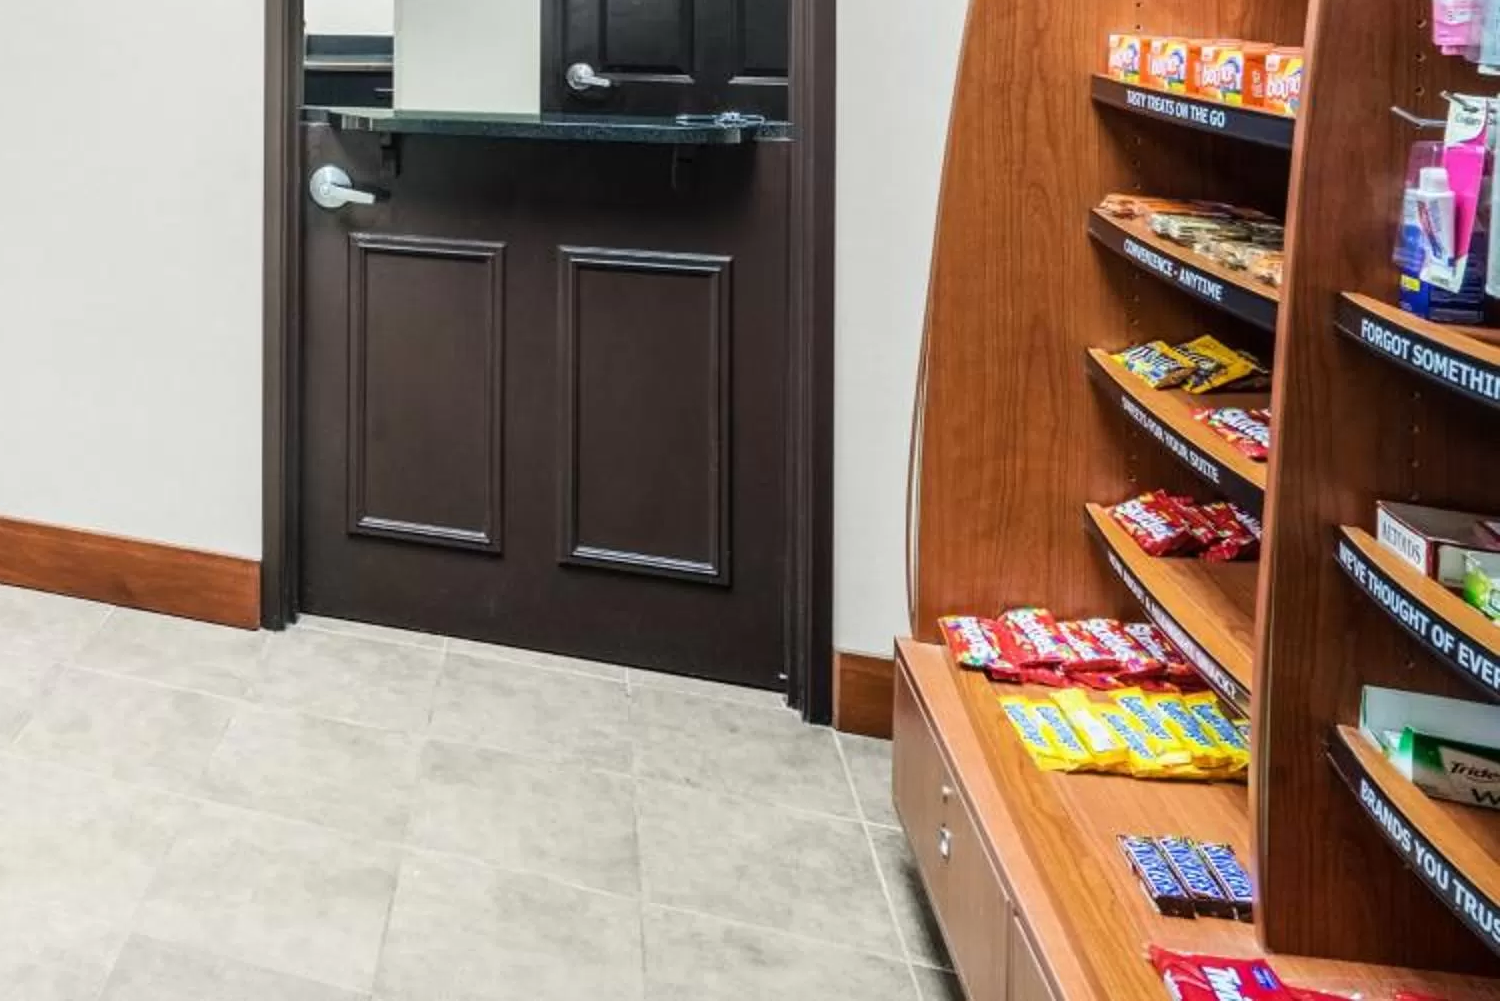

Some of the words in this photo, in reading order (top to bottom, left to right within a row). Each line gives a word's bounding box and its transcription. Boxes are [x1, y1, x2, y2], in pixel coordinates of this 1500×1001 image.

[1147, 92, 1176, 117] TREATS
[1176, 101, 1189, 119] ON
[1190, 104, 1209, 126] THE
[1209, 110, 1227, 129] GO
[1122, 237, 1174, 278] CONVENIENCE
[1179, 267, 1225, 302] ANYTIME
[1360, 318, 1409, 360] FORGOT
[1366, 567, 1431, 637] THOUGHT
[1430, 623, 1456, 654] OF
[1359, 777, 1412, 853] BRANDS
[1413, 838, 1450, 891] YOU
